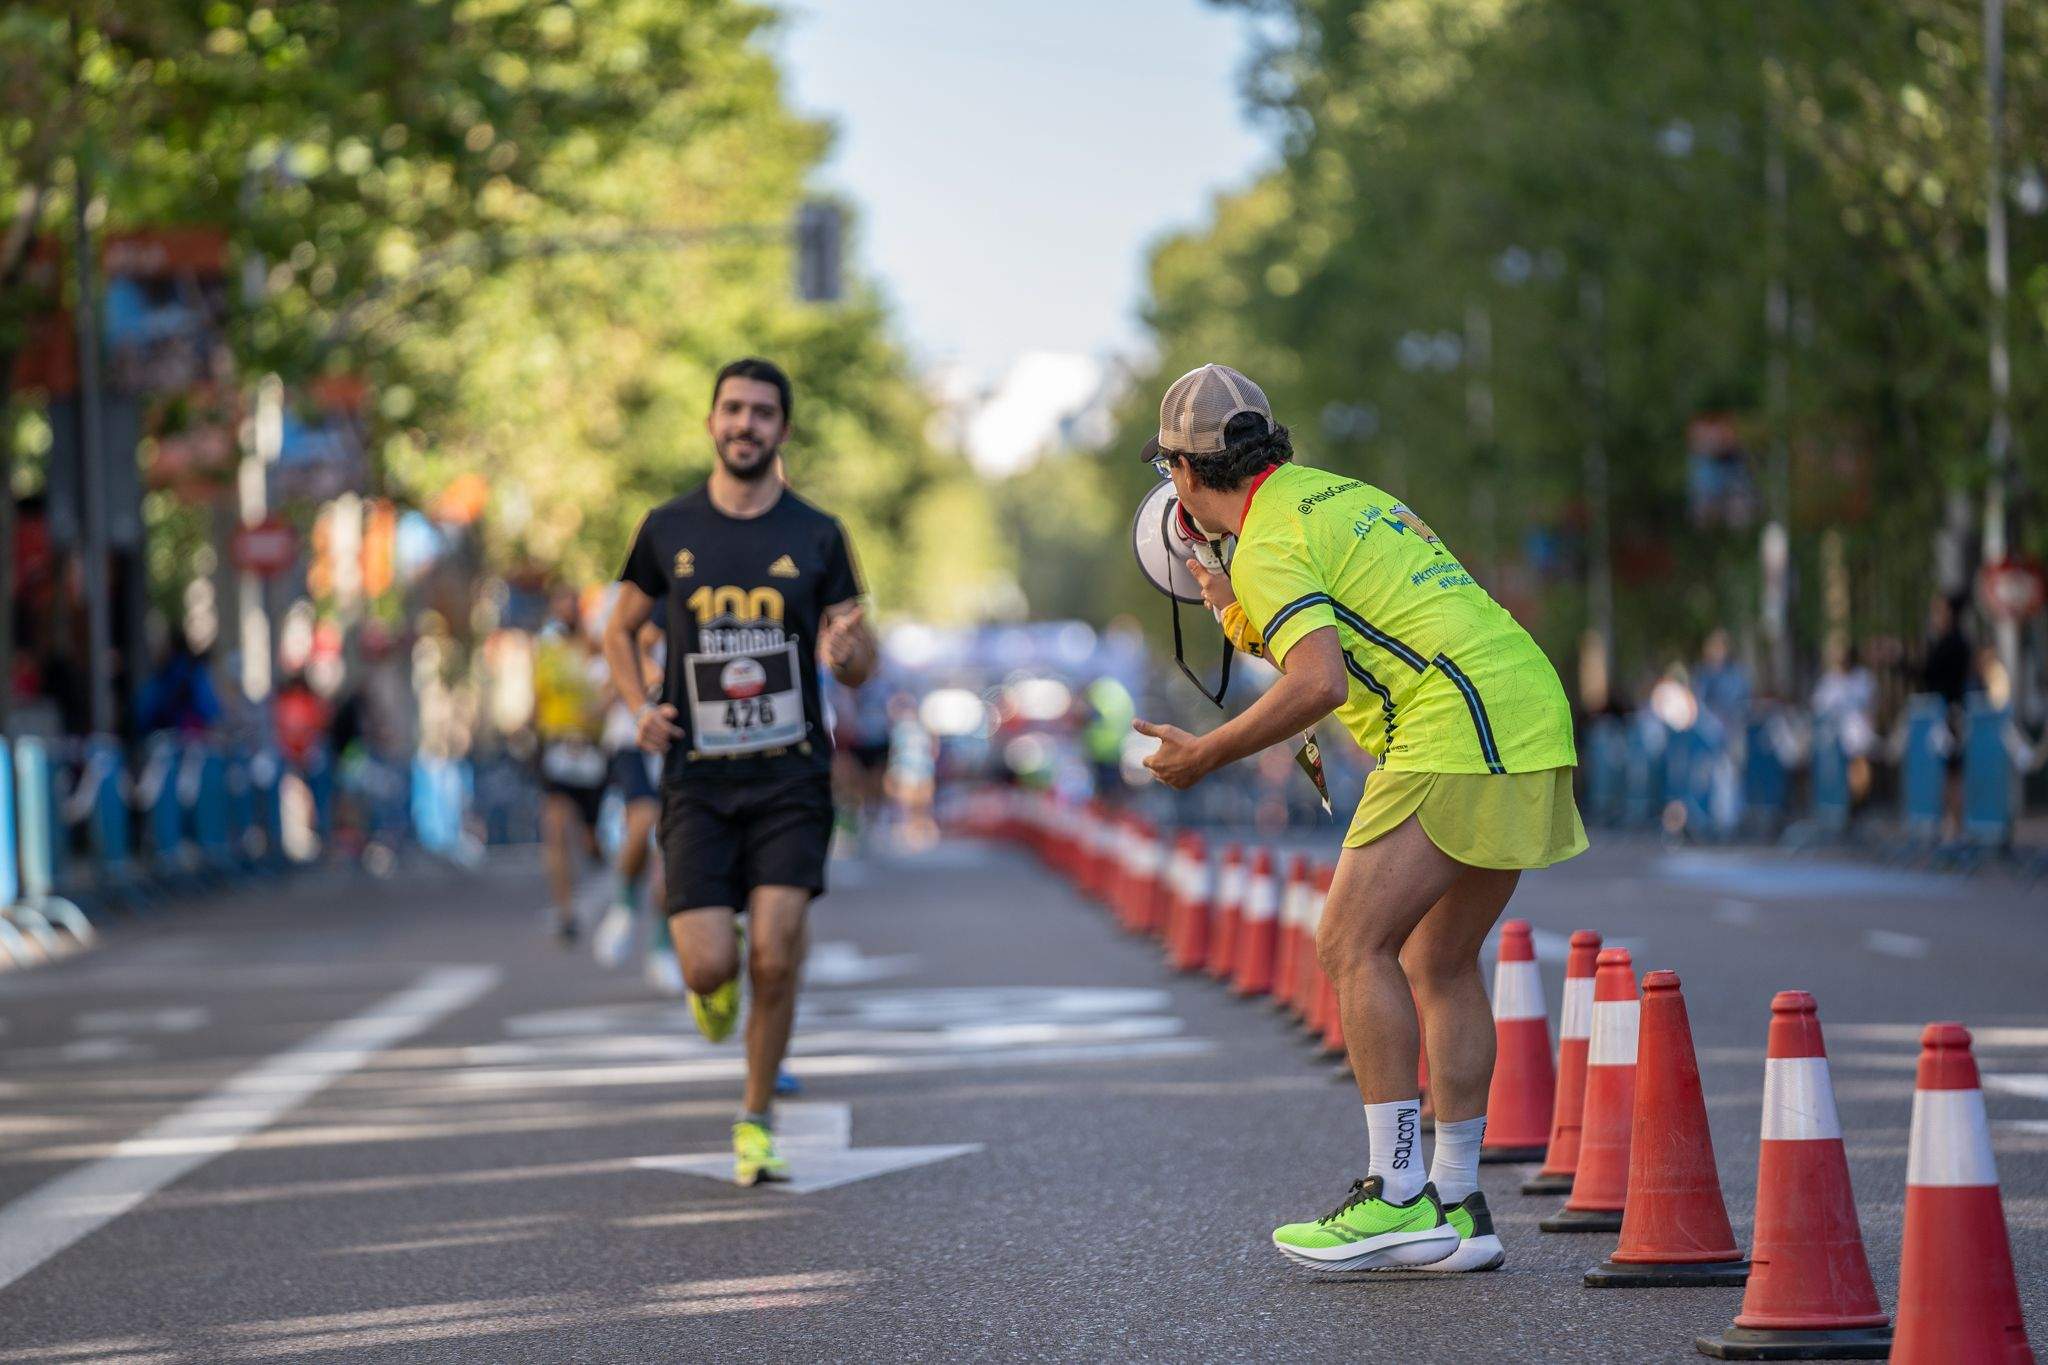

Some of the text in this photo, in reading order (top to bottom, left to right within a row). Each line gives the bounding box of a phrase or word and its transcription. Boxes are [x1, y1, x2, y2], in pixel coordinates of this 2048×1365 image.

[686, 585, 785, 625] 100
[723, 697, 776, 729] 426
[1392, 1108, 1418, 1170] saucony
